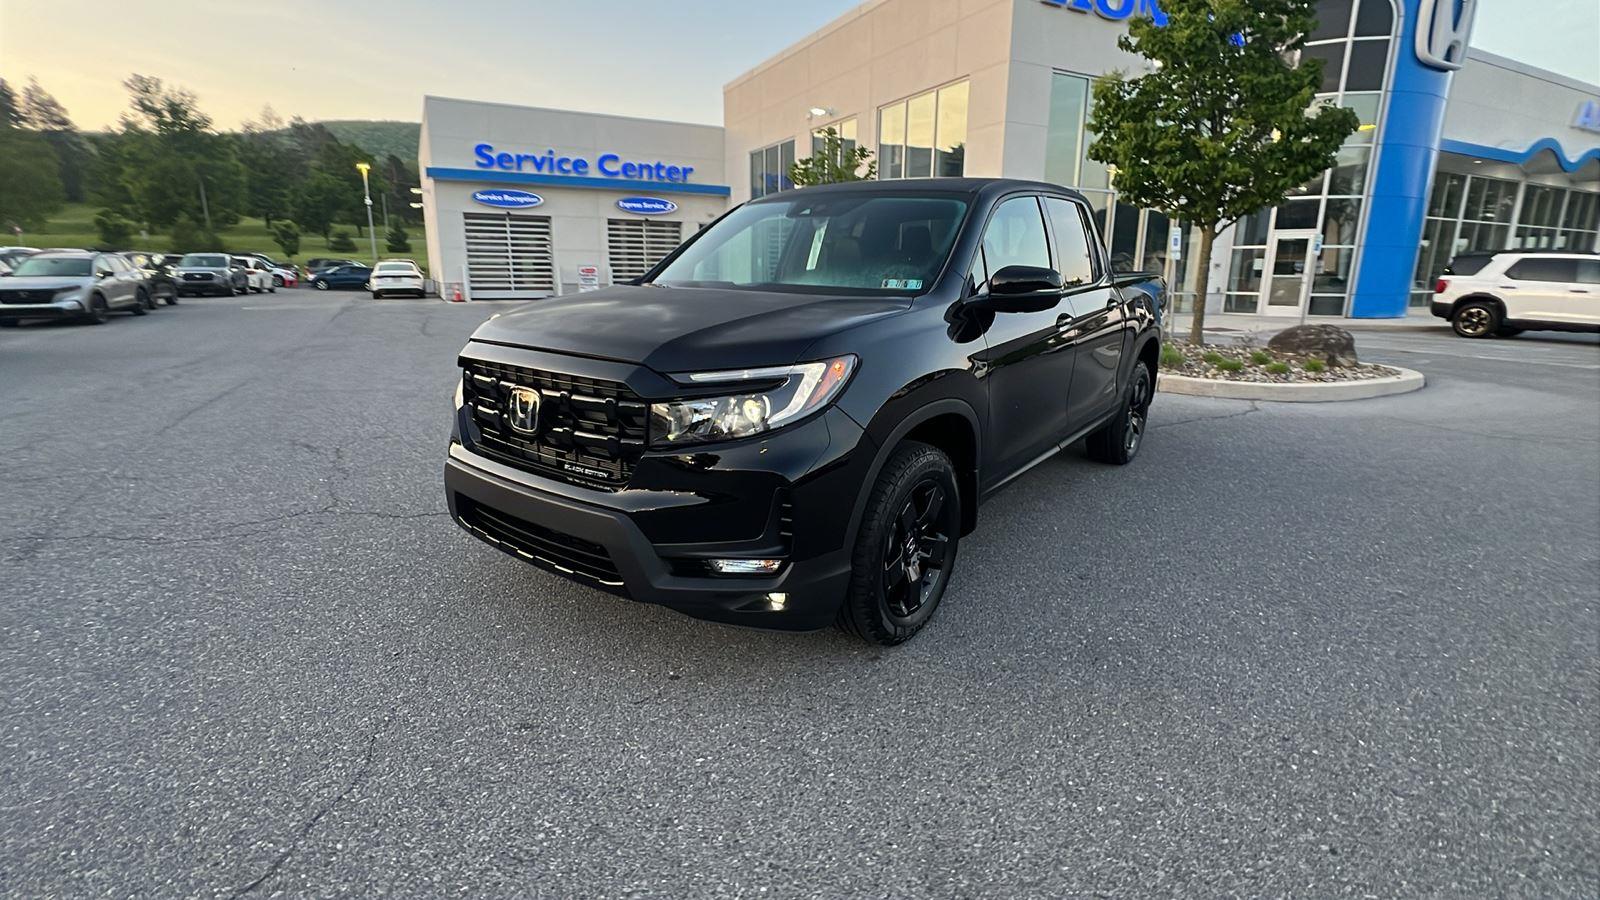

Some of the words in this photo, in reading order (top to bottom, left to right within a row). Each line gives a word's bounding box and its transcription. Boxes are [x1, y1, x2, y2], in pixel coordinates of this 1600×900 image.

[474, 144, 588, 175] Service
[597, 154, 694, 183] Center
[475, 193, 503, 201] Service
[618, 200, 642, 209] Express
[564, 464, 584, 473] BLACK
